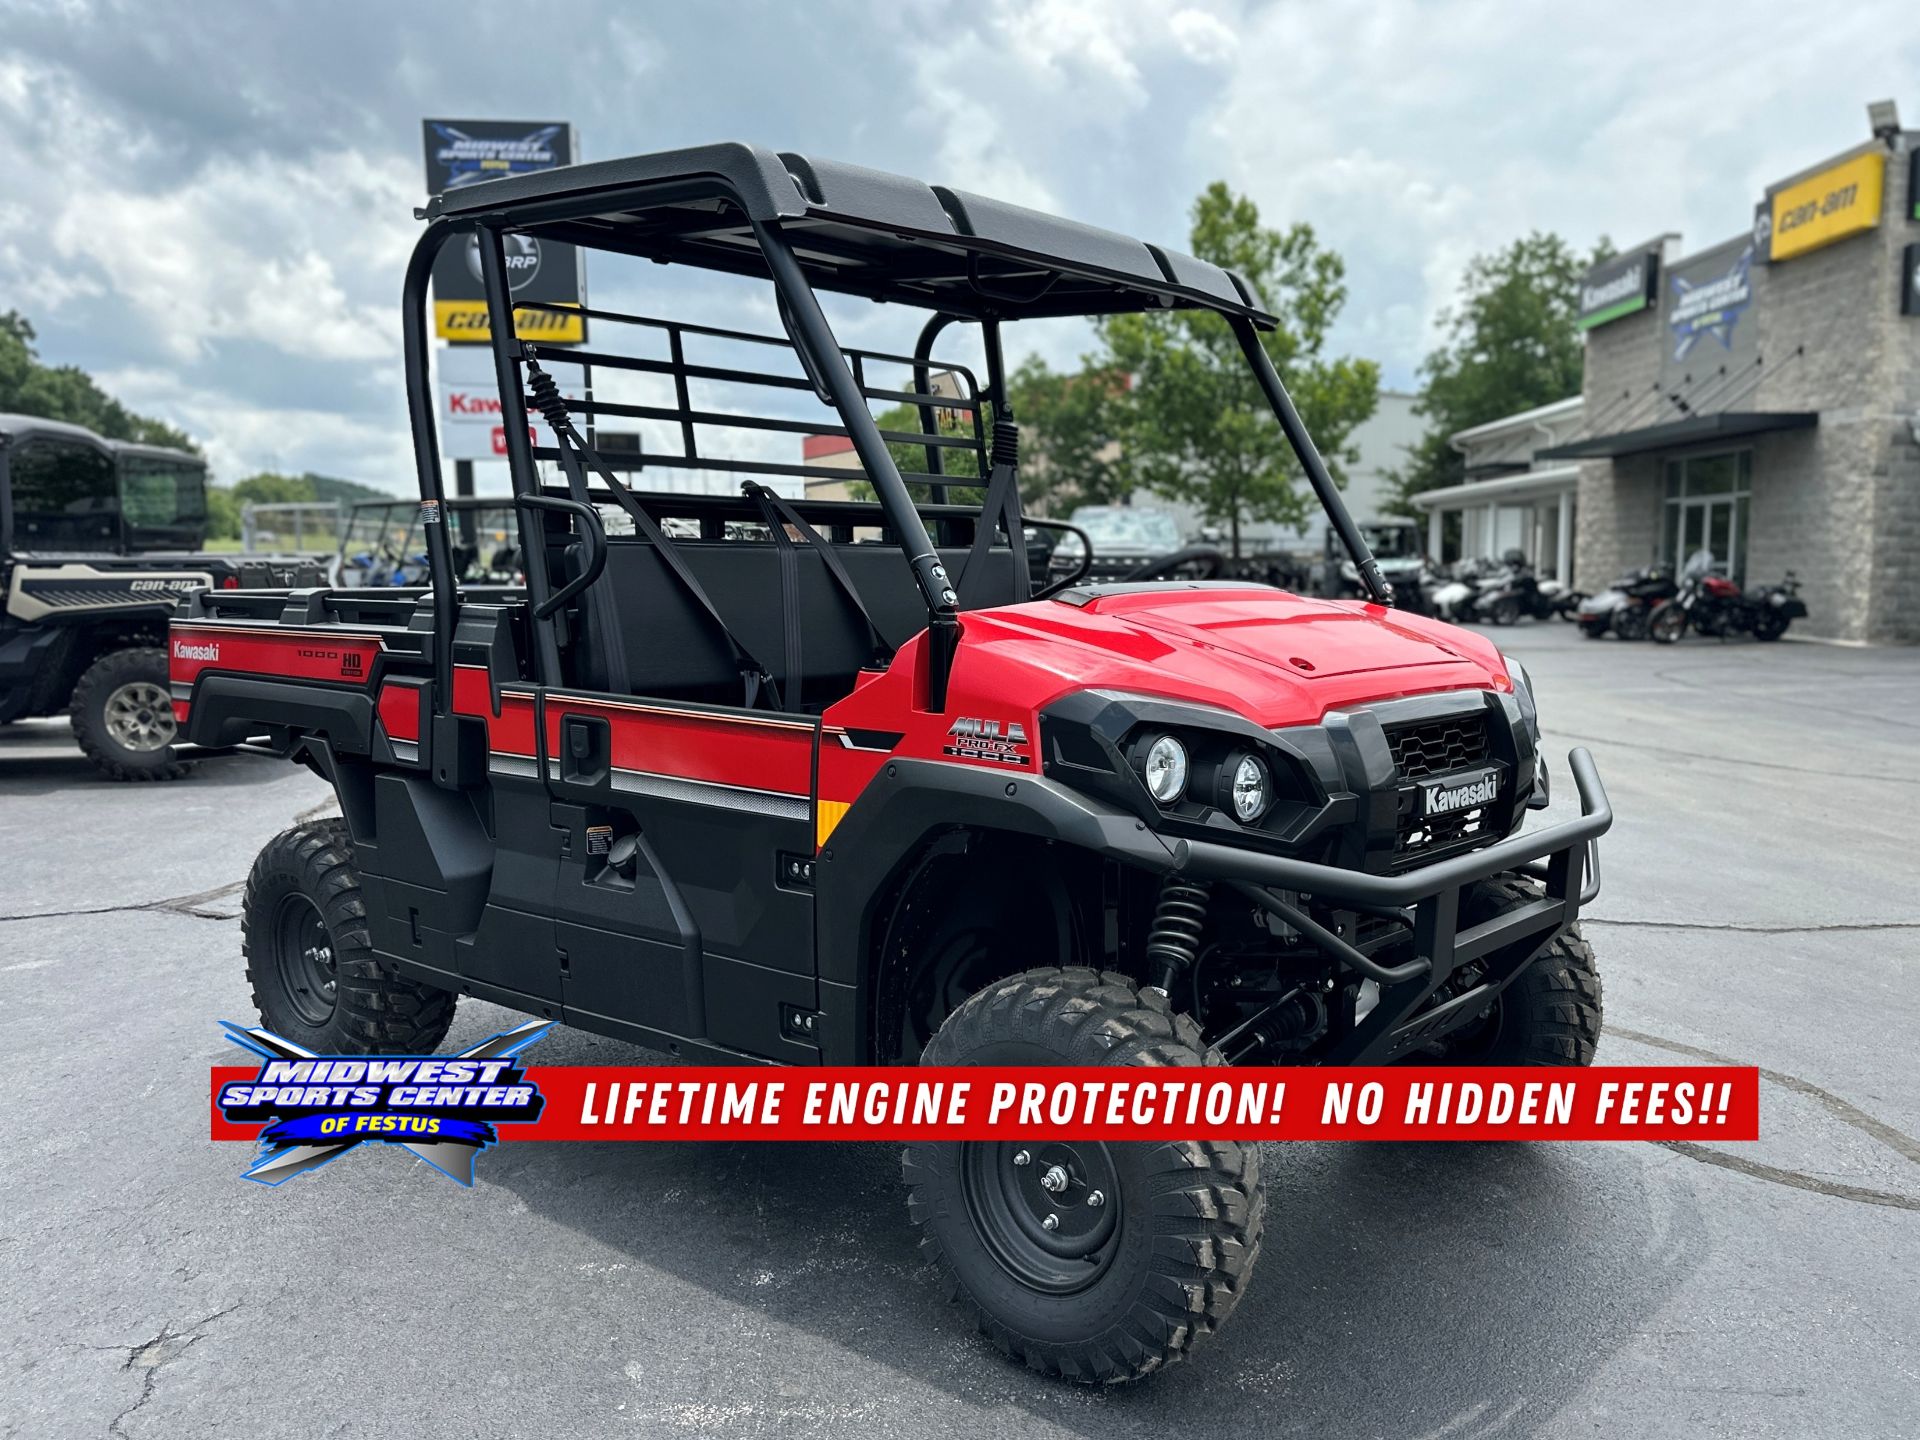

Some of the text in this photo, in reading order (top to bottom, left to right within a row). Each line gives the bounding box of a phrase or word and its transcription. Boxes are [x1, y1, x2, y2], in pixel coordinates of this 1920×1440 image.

[174, 641, 220, 662] Kawasaki
[343, 653, 361, 668] HD
[947, 716, 1028, 745] MULE
[951, 747, 1021, 763] 1000
[1426, 774, 1497, 815] Kawasaki
